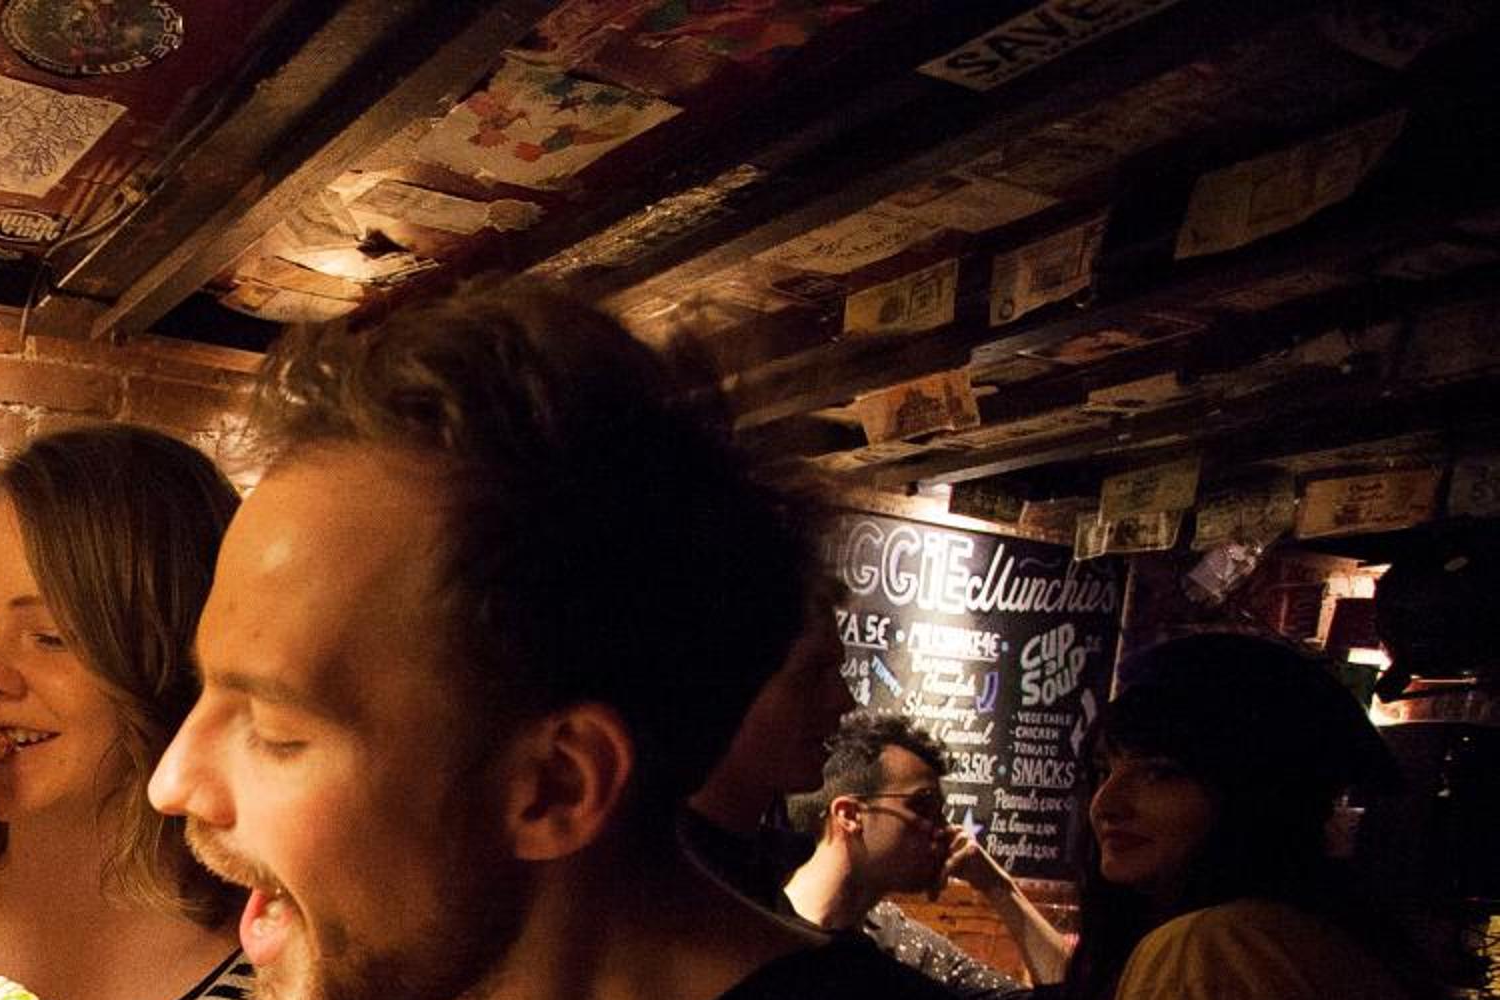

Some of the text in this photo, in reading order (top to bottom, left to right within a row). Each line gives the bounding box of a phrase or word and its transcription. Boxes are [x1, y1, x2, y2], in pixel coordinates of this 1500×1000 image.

[843, 521, 975, 616] GGIE
[1021, 623, 1075, 669] CUP
[1021, 645, 1086, 705] SOUP
[1011, 756, 1075, 786] SNACKS
